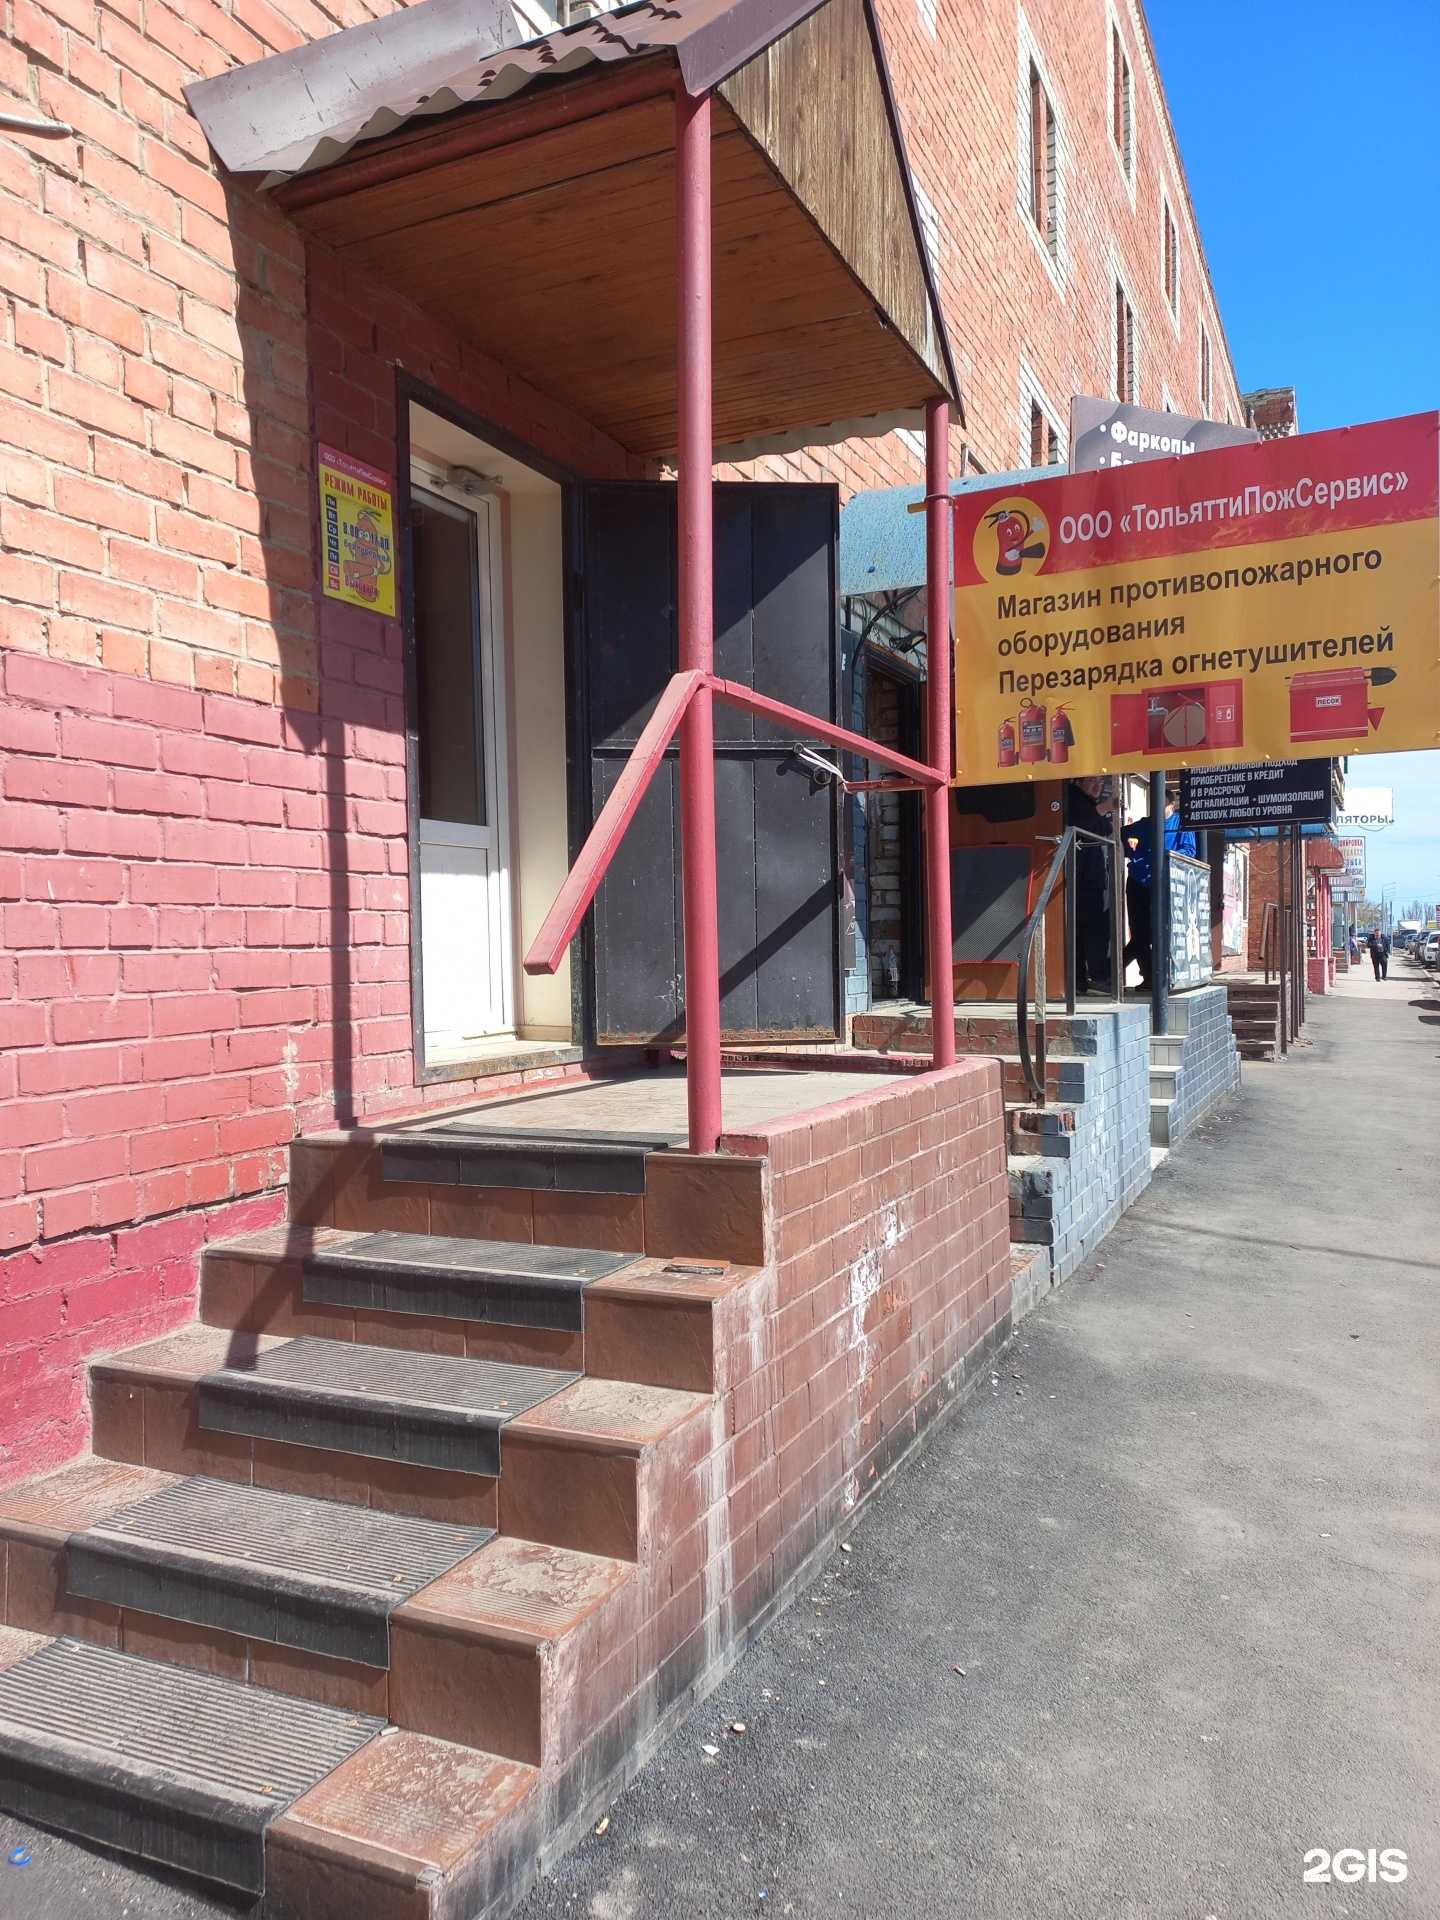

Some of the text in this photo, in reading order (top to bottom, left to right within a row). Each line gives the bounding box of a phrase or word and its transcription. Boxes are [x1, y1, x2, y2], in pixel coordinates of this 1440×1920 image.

[1110, 421, 1195, 454] Фаркопы
[324, 471, 387, 512] РЕЖИМ РАБОТЫ
[1059, 471, 1409, 544] ООО «ТольяттиПожСервис»
[998, 549, 1383, 620] Магазин противопожарного
[997, 615, 1186, 658] оборудования
[999, 626, 1394, 696] Перезарядка огнетушителей
[1317, 697, 1340, 706] ПЕСОК
[1190, 768, 1285, 786] ПРИОБРЕТЕНИЕ В КРЕДИТ
[1190, 784, 1246, 798] И В РАССРОЧКУ
[1190, 790, 1324, 809] СИГНАЛИЗАЦИИ ШУМОИЗОЛЯЦИЯ
[1190, 805, 1293, 820] АВТОЗВУК ЛЮБОГО УРОВНЯ
[1334, 815, 1388, 824] ЛЯТОРЫ
